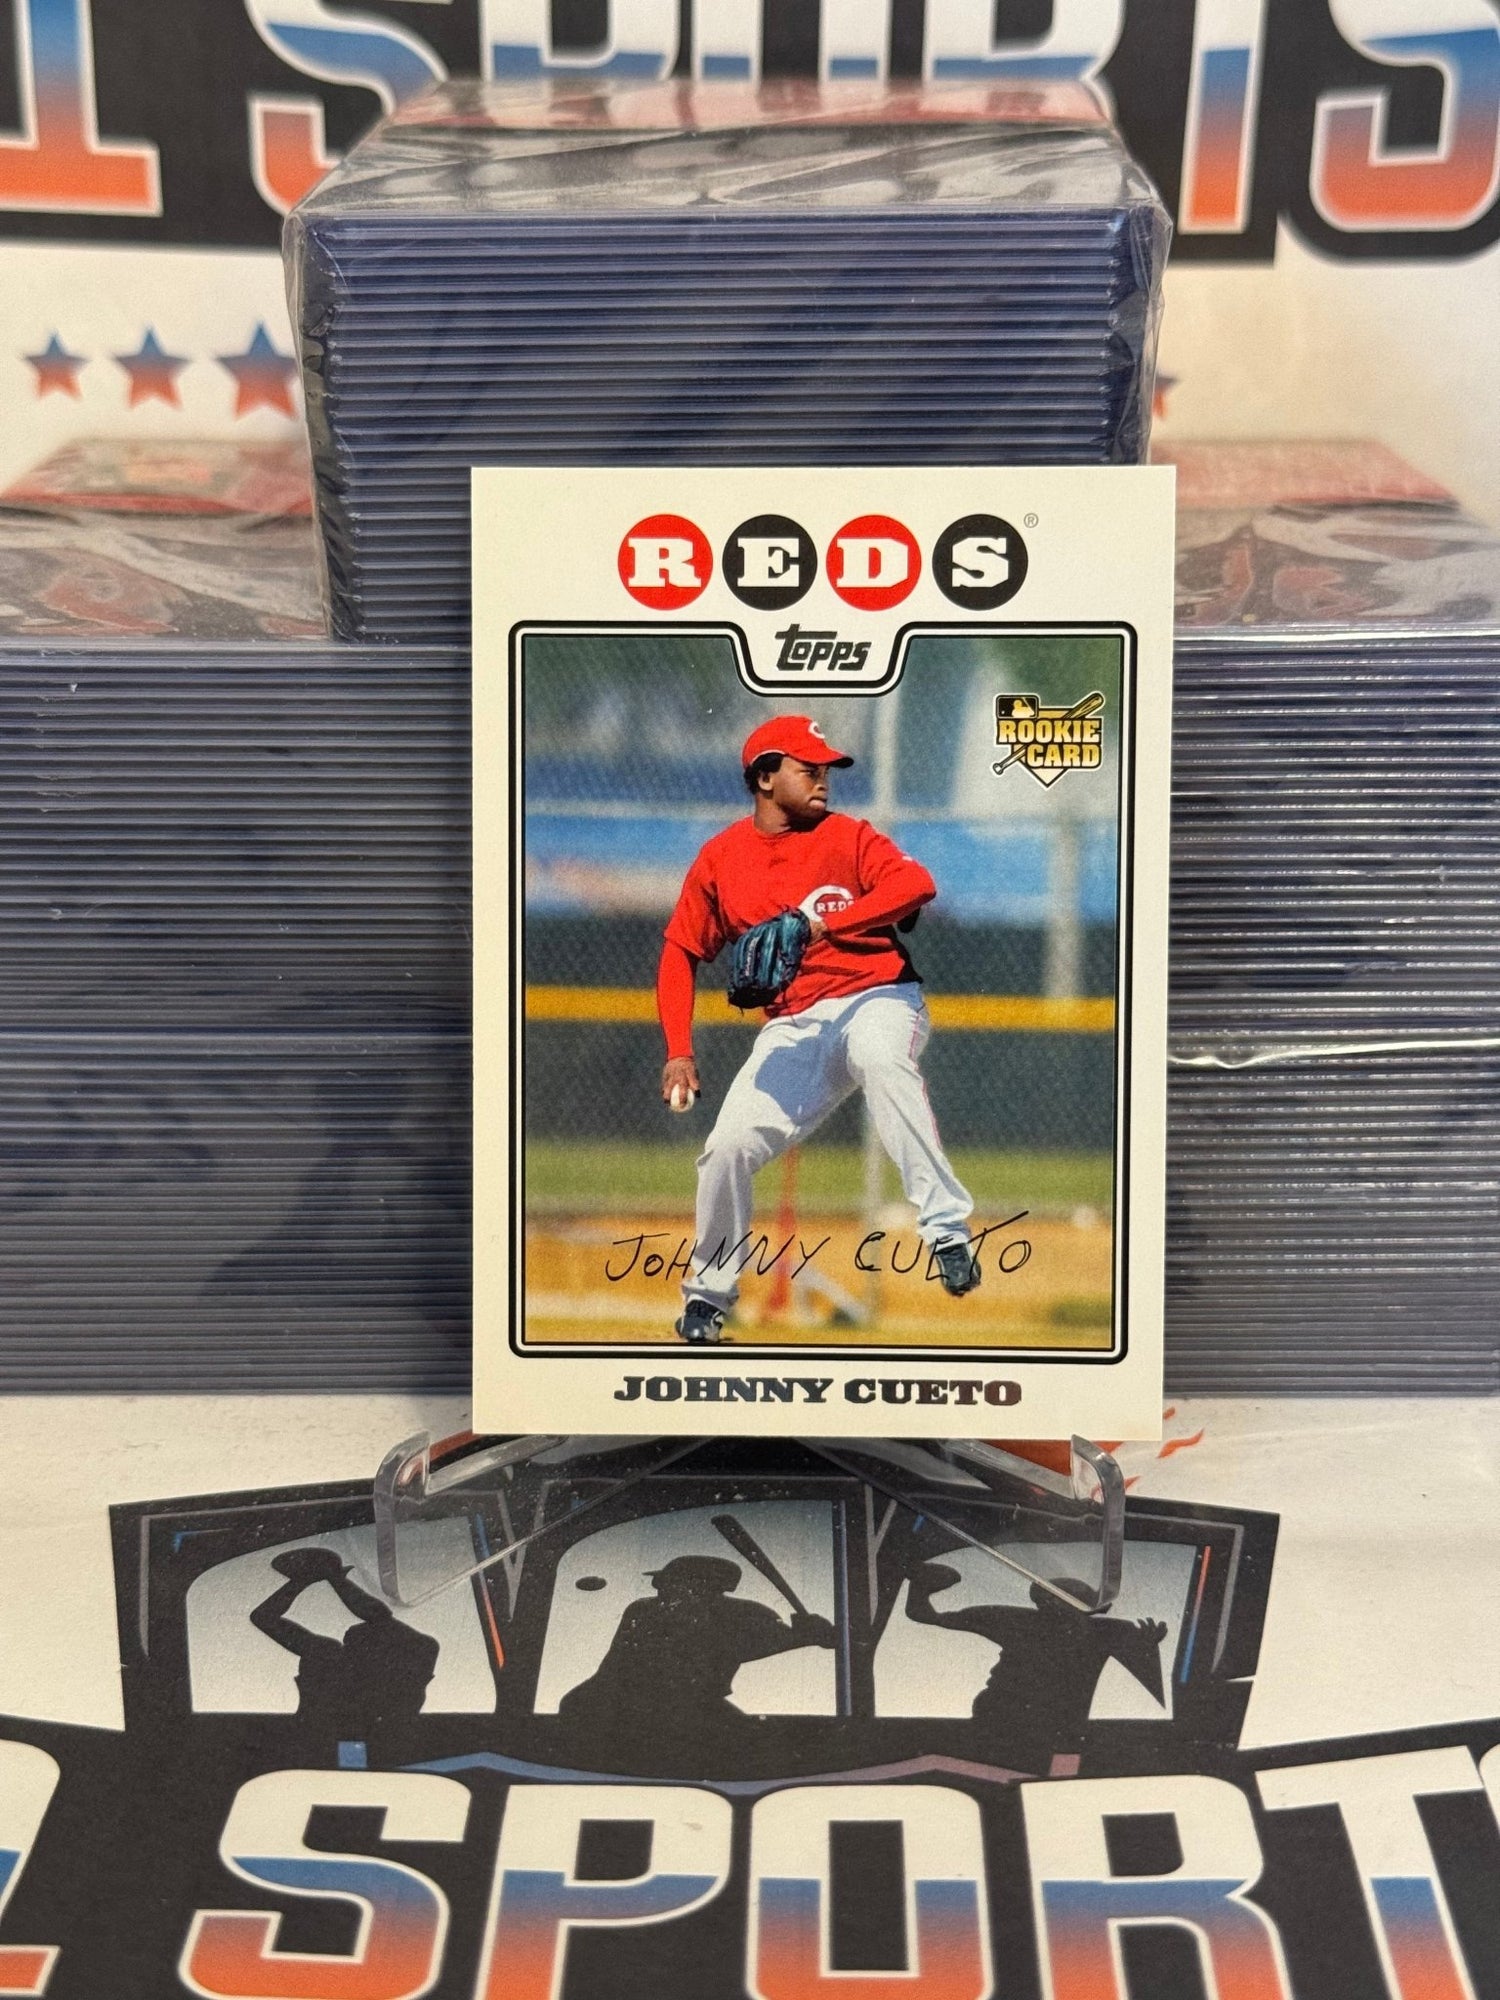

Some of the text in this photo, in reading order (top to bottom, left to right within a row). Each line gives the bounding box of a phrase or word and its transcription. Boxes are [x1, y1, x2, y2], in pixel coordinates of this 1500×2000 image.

[998, 719, 1101, 743] ROOKIE
[1026, 744, 1100, 767] CARD
[605, 1210, 1032, 1281] JOHNNY CUETO
[613, 1376, 1022, 1406] JOHNNY CUETO
